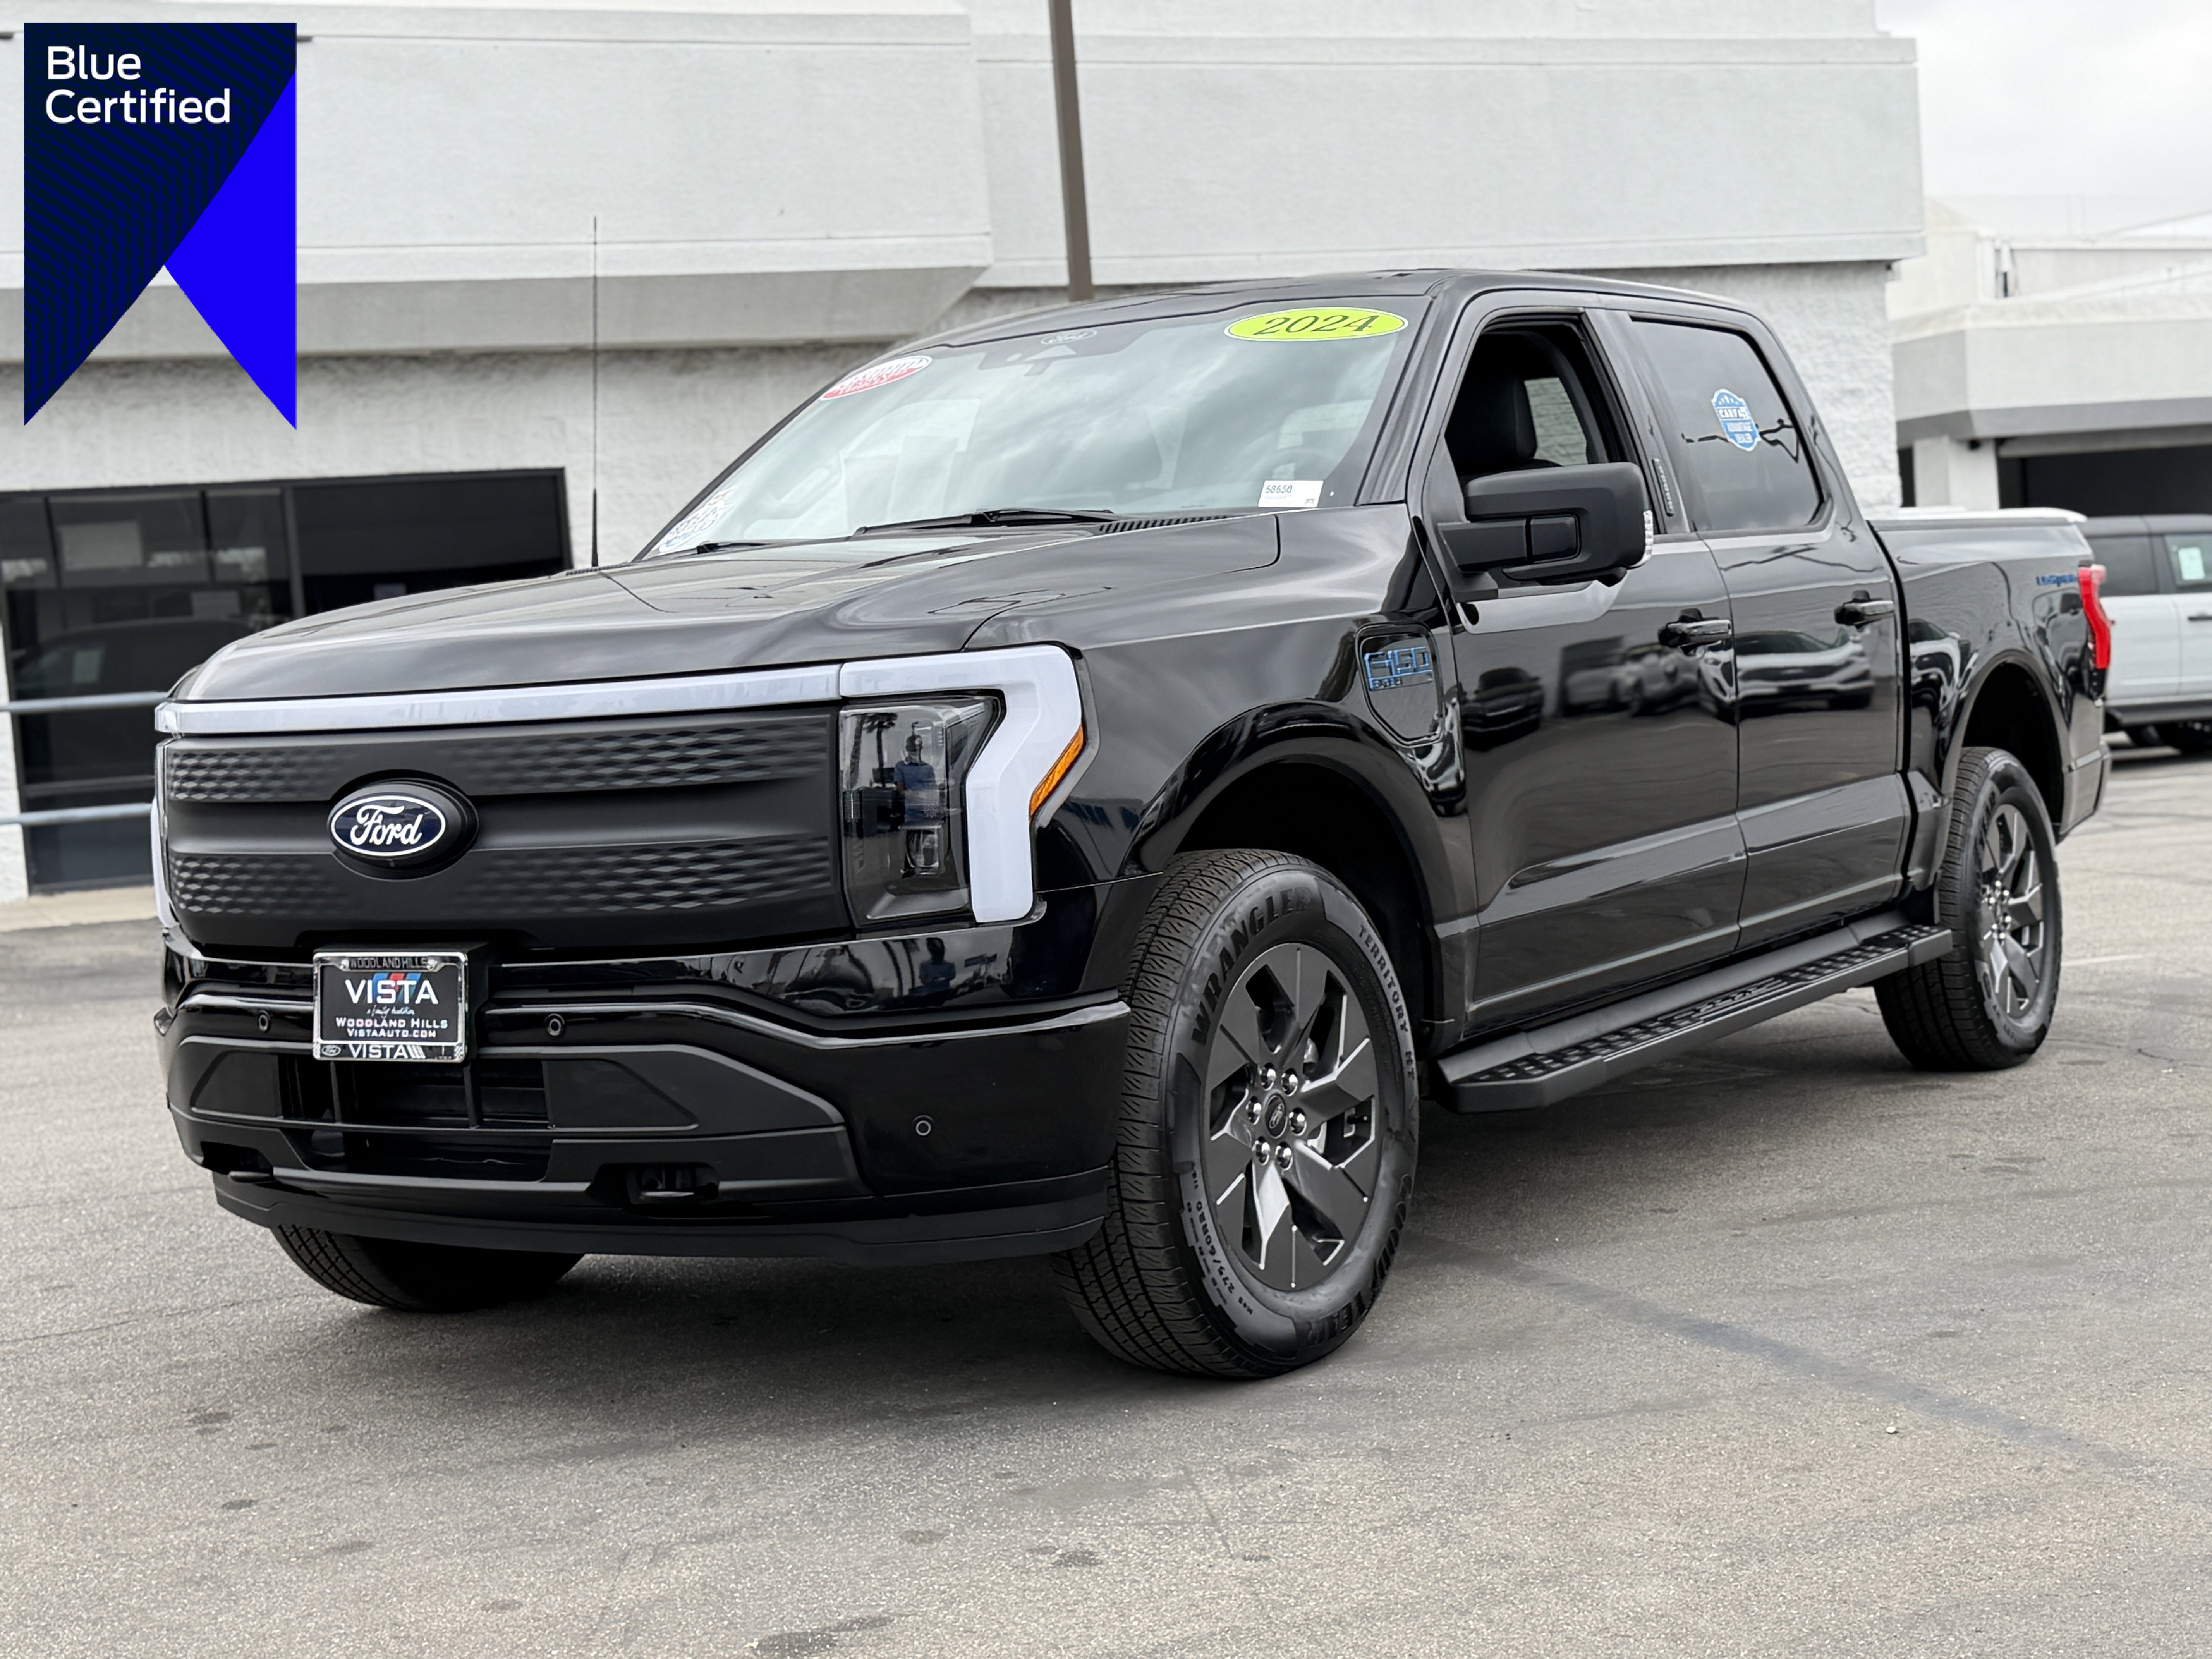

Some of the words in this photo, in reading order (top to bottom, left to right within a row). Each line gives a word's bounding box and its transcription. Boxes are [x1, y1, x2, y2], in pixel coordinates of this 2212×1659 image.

[1253, 314, 1380, 335] 2024
[350, 804, 424, 845] Ford
[351, 957, 401, 969] WOODLAND
[402, 957, 428, 969] HILLS
[1191, 887, 1312, 1046] WRANGLER
[1357, 924, 1408, 1033] TERRITORY
[345, 979, 439, 1005] VISTA
[336, 1017, 406, 1028] WOODLAND
[411, 1018, 448, 1029] HILLS
[349, 1044, 409, 1058] VISTA
